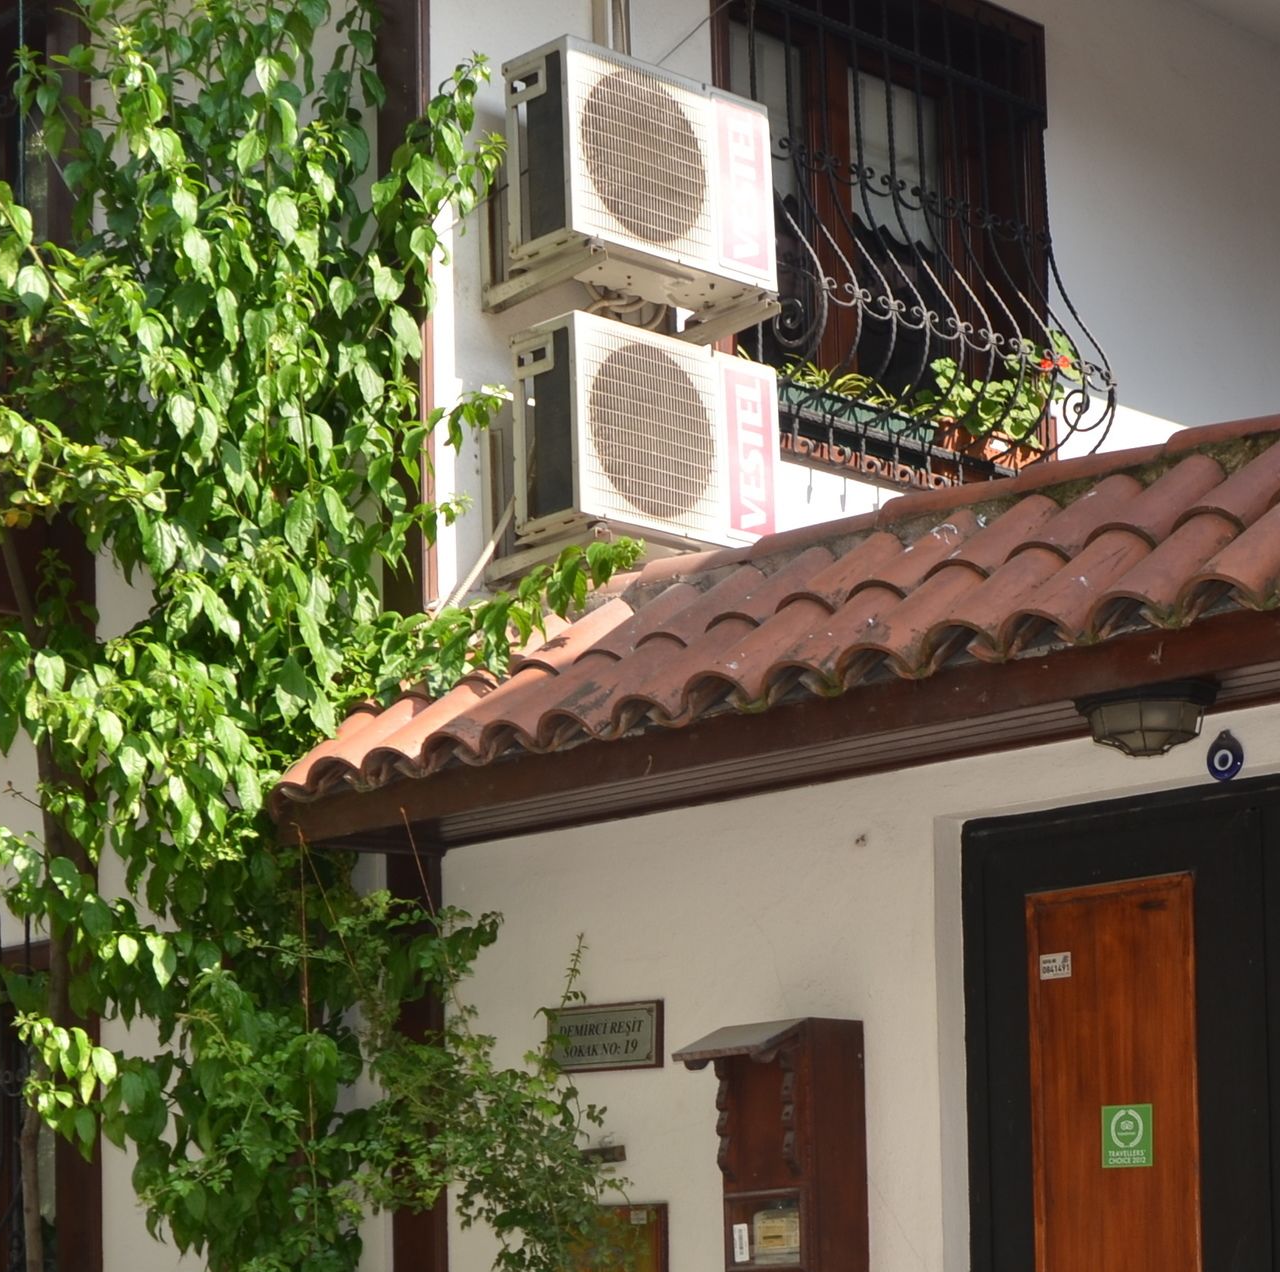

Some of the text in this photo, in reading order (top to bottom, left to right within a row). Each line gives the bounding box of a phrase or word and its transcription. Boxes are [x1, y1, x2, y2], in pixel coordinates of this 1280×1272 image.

[735, 377, 767, 530] VESTEL
[609, 1016, 644, 1036] REŞİT
[624, 1038, 638, 1054] 19
